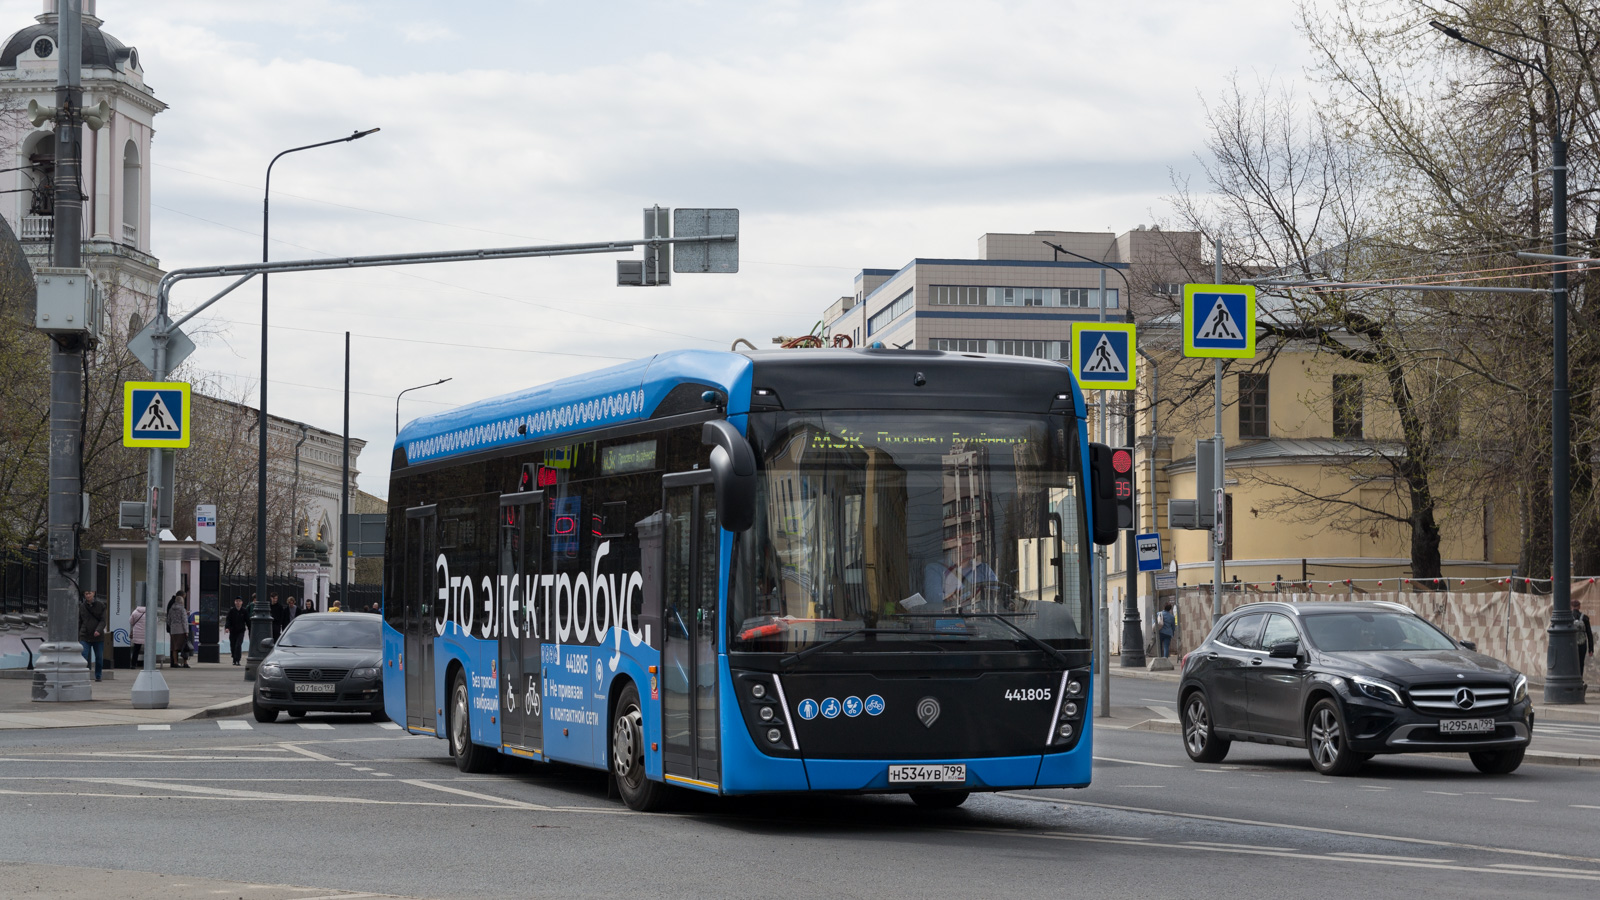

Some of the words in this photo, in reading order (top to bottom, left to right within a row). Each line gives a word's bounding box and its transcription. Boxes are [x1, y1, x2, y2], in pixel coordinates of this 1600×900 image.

[1115, 481, 1131, 497] 35
[435, 553, 474, 638] Это
[565, 653, 588, 675] 441805
[549, 679, 557, 697] Не
[557, 684, 584, 702] привязан
[1004, 688, 1052, 701] 441805
[554, 706, 586, 724] контактной
[585, 711, 599, 726] сети
[1442, 720, 1479, 731] Н295АА
[1480, 719, 1493, 728] 799
[893, 767, 942, 780] Н534УВ
[944, 765, 963, 777] 799
